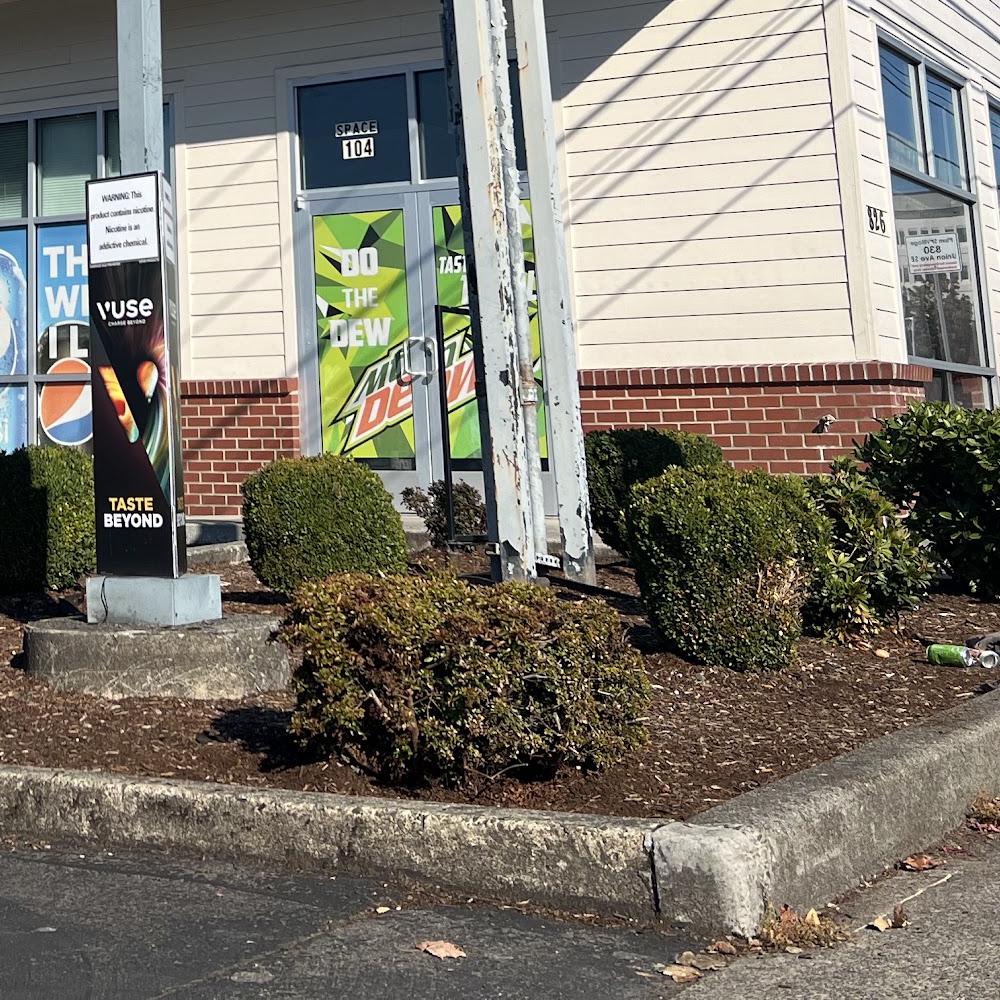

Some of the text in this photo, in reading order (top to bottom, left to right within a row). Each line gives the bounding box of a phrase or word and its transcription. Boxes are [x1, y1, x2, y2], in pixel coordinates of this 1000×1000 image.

[337, 121, 376, 136] SPACE
[345, 139, 372, 157] 104
[131, 190, 142, 199] This
[91, 211, 110, 221] product
[110, 208, 132, 218] contains
[105, 224, 127, 234] Nicotine
[128, 223, 133, 231] is
[99, 239, 122, 250] addictive
[340, 246, 379, 277] DO
[341, 287, 379, 309] THE
[329, 317, 391, 348] DEW
[108, 497, 154, 511] TASTE
[103, 513, 164, 528] BEYOND
